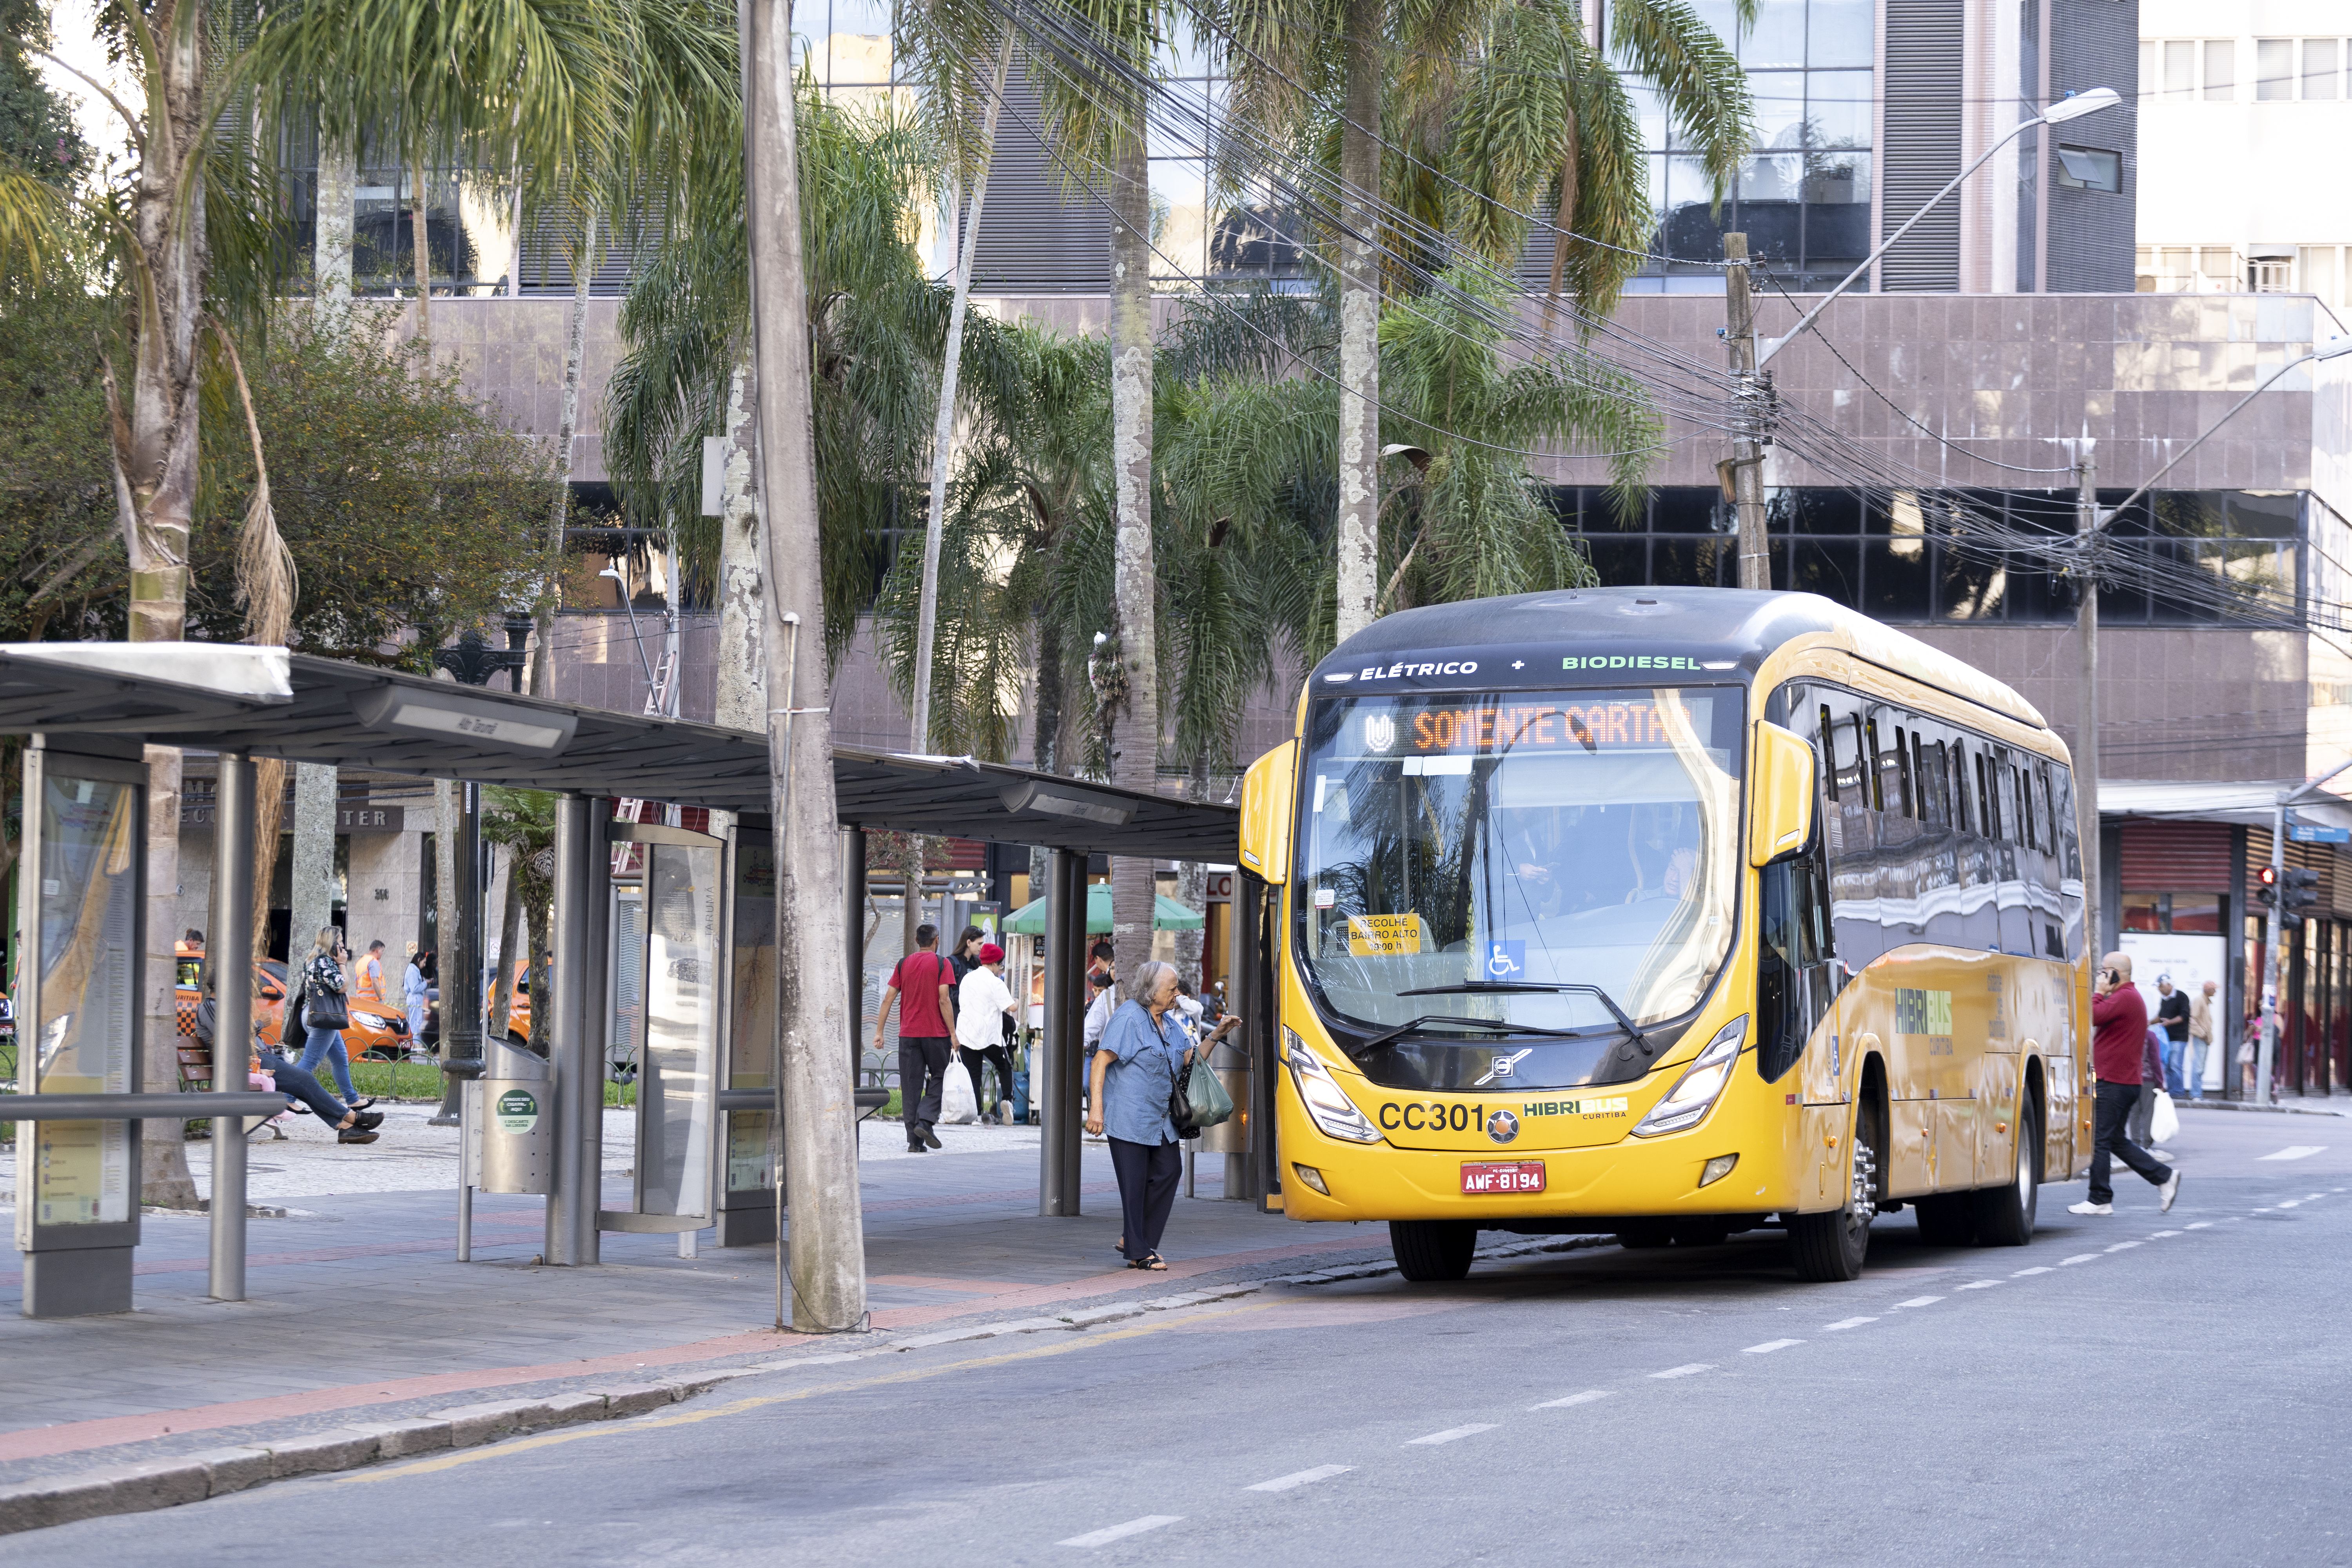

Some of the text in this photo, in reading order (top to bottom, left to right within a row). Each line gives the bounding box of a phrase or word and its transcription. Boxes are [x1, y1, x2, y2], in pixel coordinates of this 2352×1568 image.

[1359, 661, 1478, 681] ELÉTRICO
[1562, 656, 1701, 671] BIODIESEL
[1414, 706, 1555, 749] SOMENTE
[1071, 805, 1089, 815] Tarumã
[704, 886, 714, 937] TARUMÃ
[1361, 918, 1408, 927] RECOLHE
[1351, 929, 1417, 940] BAIRRO ALTO
[1370, 943, 1393, 951] 19:00
[1524, 1097, 1628, 1116] HIBRIBUS
[1379, 1103, 1483, 1132] CC301
